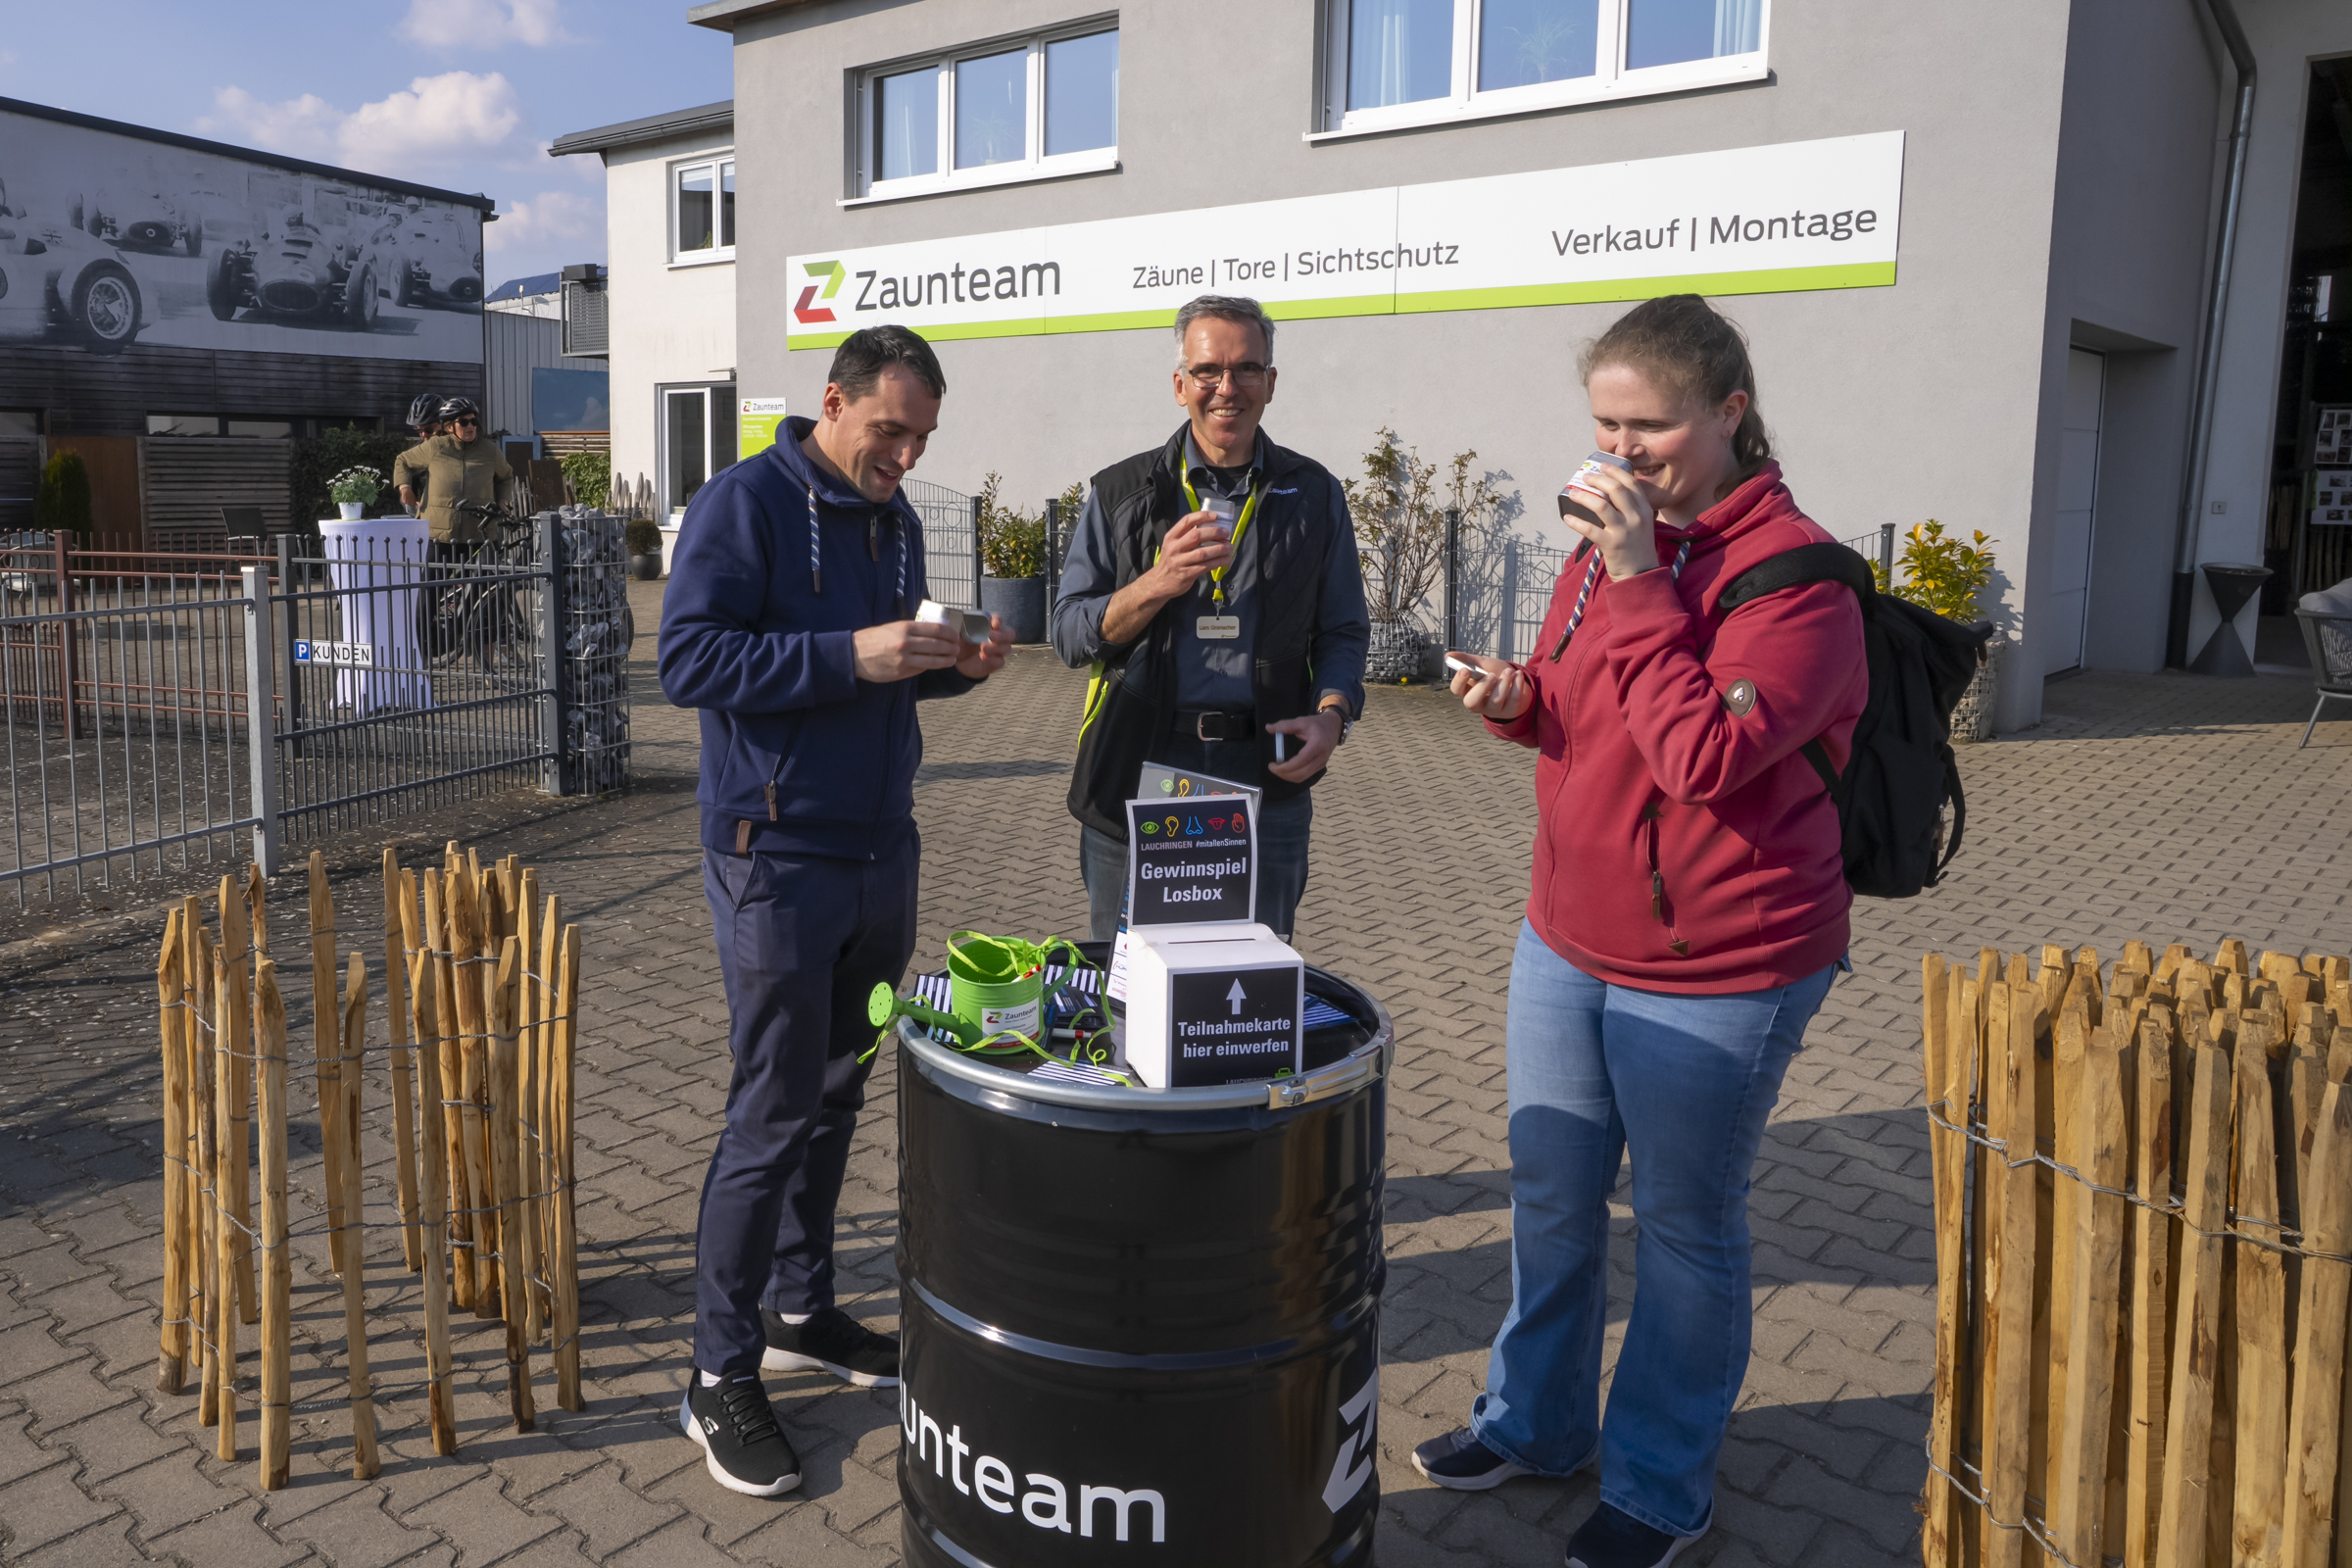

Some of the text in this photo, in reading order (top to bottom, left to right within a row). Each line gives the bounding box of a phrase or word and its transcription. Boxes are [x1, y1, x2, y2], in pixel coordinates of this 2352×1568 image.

[1551, 219, 1680, 256] Verkauf
[1709, 209, 1878, 244] Montage
[1133, 266, 1203, 289] Zäune
[1223, 258, 1276, 281] Tore
[1297, 241, 1459, 275] Sichtschutz
[855, 261, 1060, 312] Zaunteam
[313, 645, 369, 662] KUNDEN
[1141, 838, 1247, 852] LAUCHRINGEN #mitallenSinnen
[1141, 857, 1247, 880] Gewinnspiel
[1162, 885, 1223, 904] Losbox
[1004, 1005, 1037, 1020] Zaunteam
[1178, 1017, 1291, 1037] Teilnahmekarte
[1183, 1038, 1289, 1058] hier einwerfen
[900, 1364, 1166, 1544] unteam
